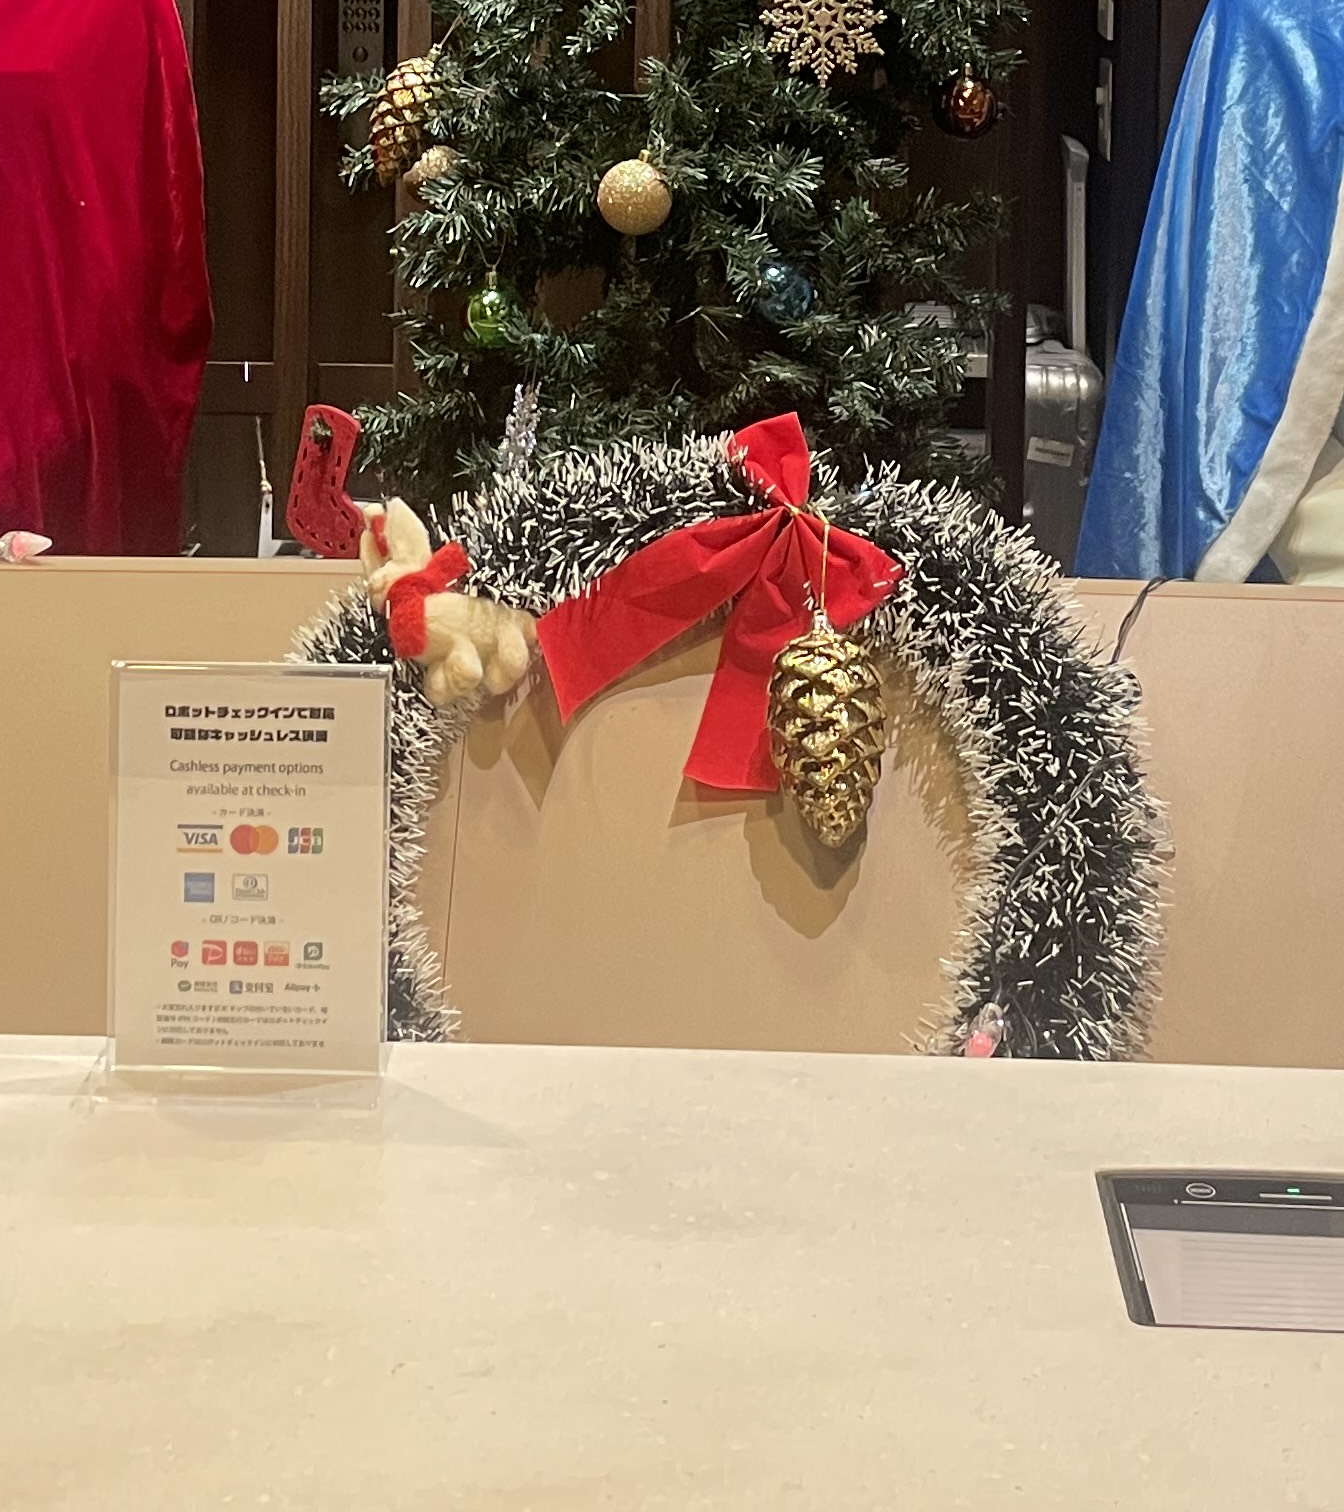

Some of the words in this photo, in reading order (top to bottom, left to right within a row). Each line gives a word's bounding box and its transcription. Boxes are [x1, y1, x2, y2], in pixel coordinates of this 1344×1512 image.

[170, 759, 220, 772] Cashless
[223, 762, 276, 775] payment
[278, 762, 324, 775] options
[186, 783, 239, 795] available
[242, 785, 253, 796] at
[256, 784, 307, 797] check-in
[183, 831, 219, 845] VISA
[170, 958, 189, 970] Pay
